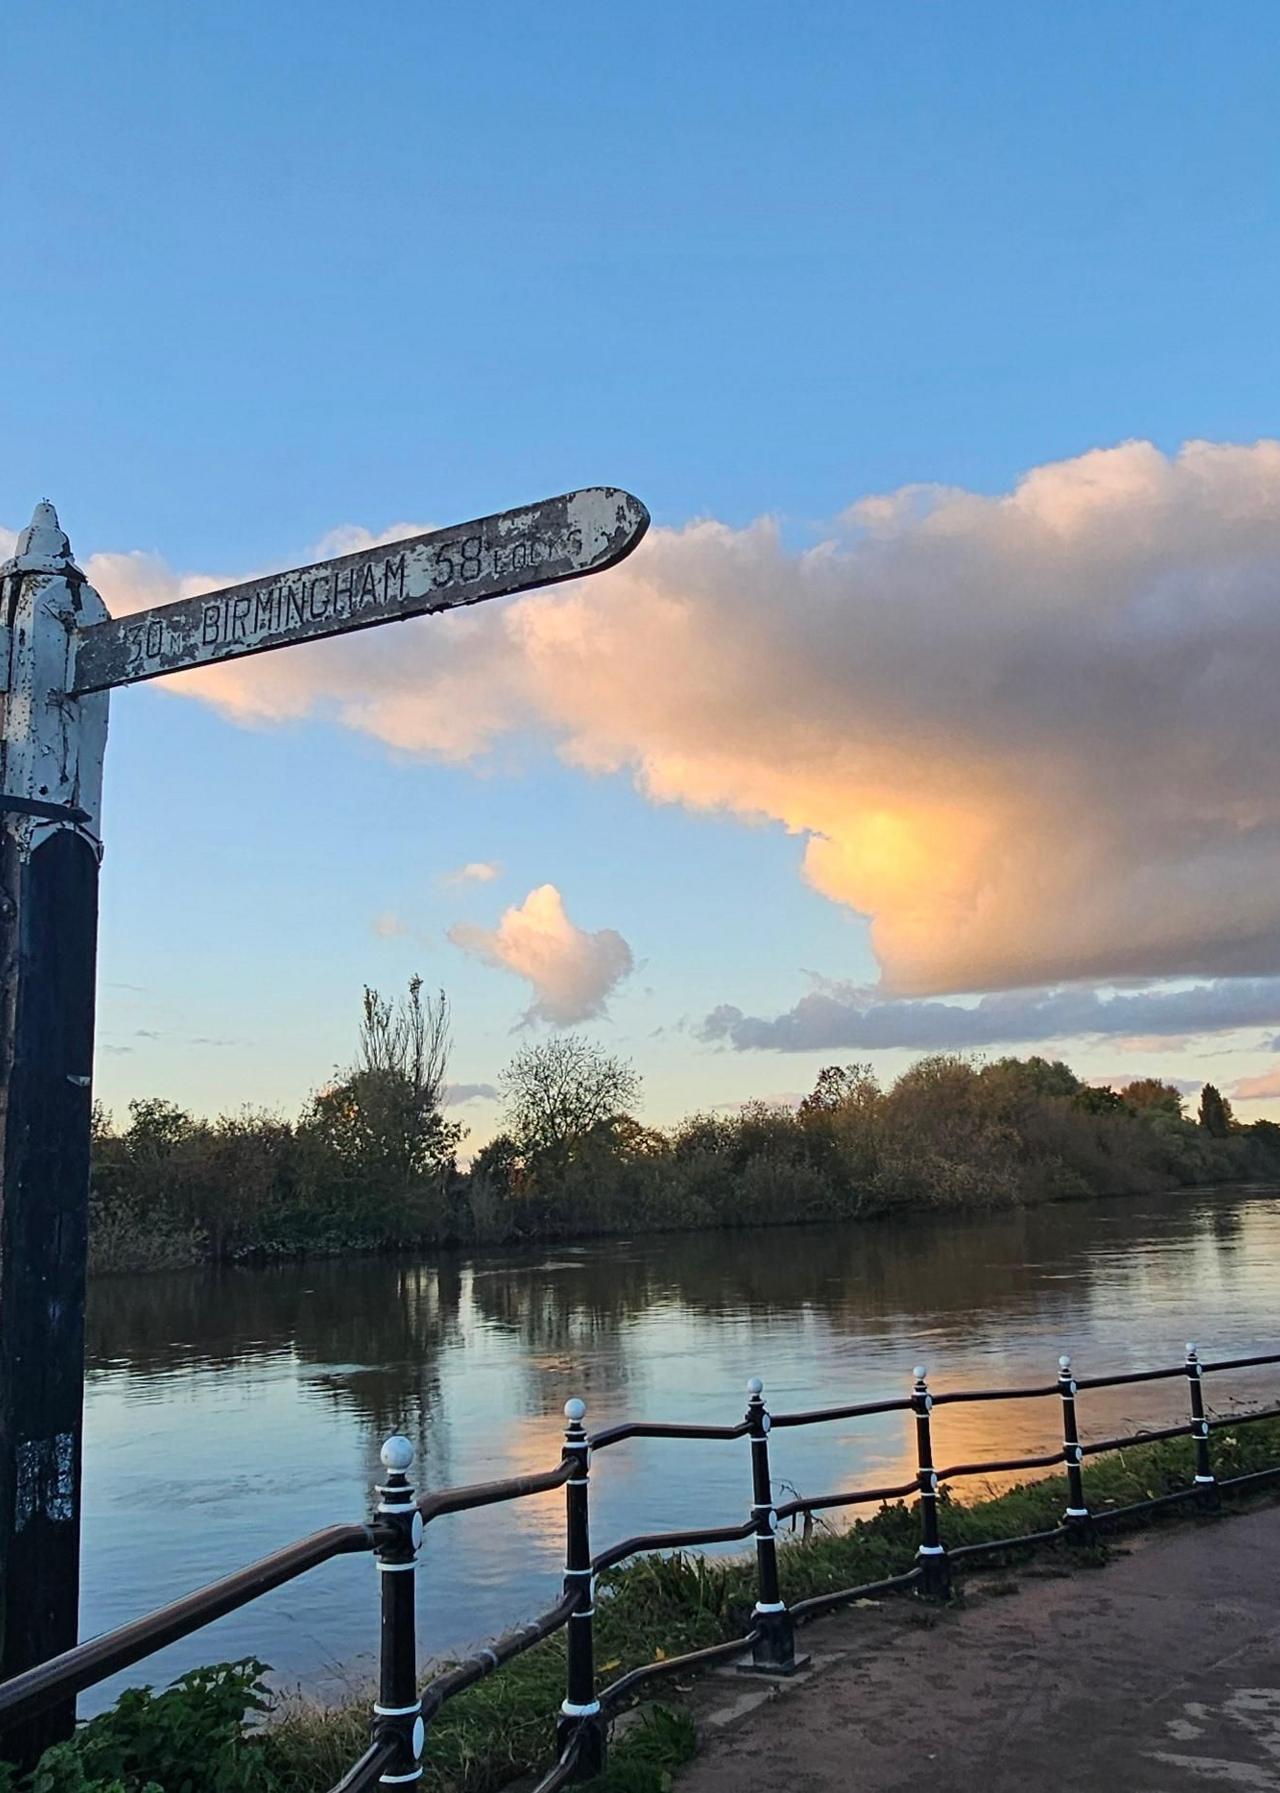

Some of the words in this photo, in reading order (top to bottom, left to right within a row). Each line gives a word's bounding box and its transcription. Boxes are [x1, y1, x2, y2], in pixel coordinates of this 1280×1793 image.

[126, 620, 163, 664] 30
[171, 632, 183, 655] M
[202, 553, 406, 646] BIRMINGHAM
[432, 536, 483, 588] 58
